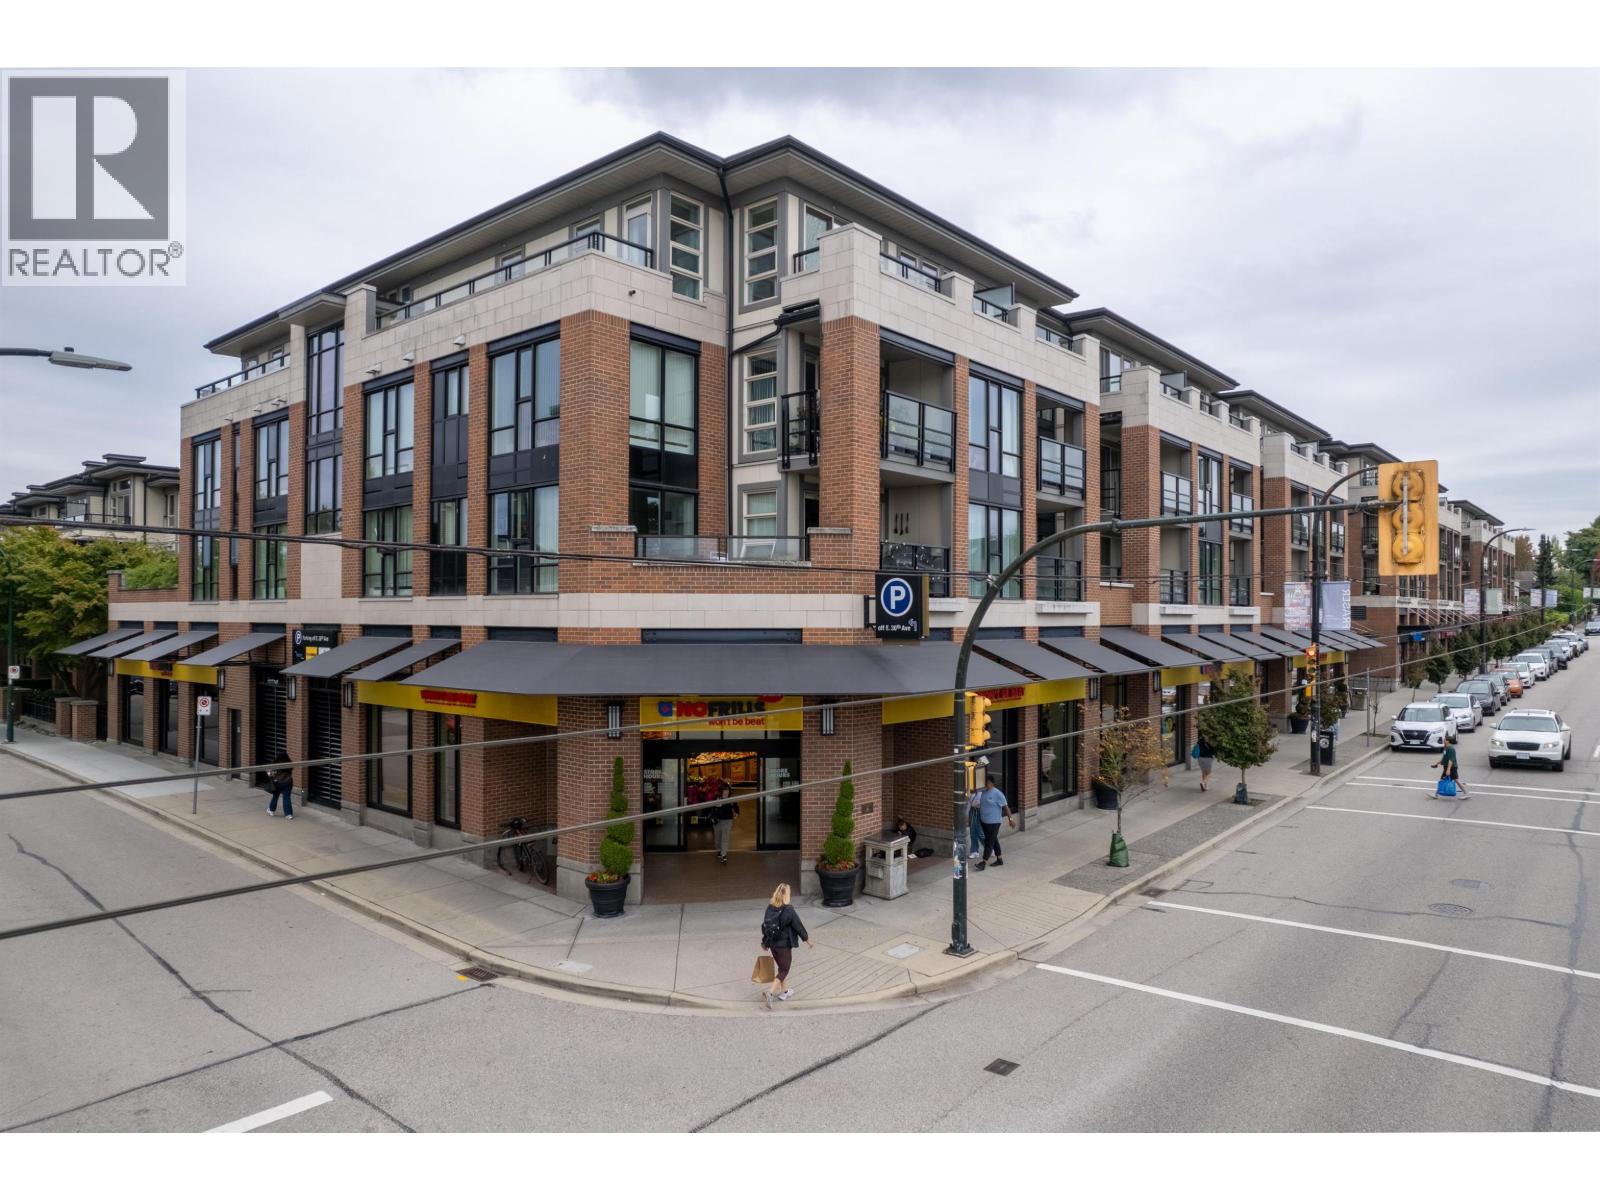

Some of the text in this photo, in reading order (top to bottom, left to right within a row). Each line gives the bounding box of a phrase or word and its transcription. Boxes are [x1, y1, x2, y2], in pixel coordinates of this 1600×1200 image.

[890, 585, 906, 610] P
[708, 716, 765, 726] wont be beat
